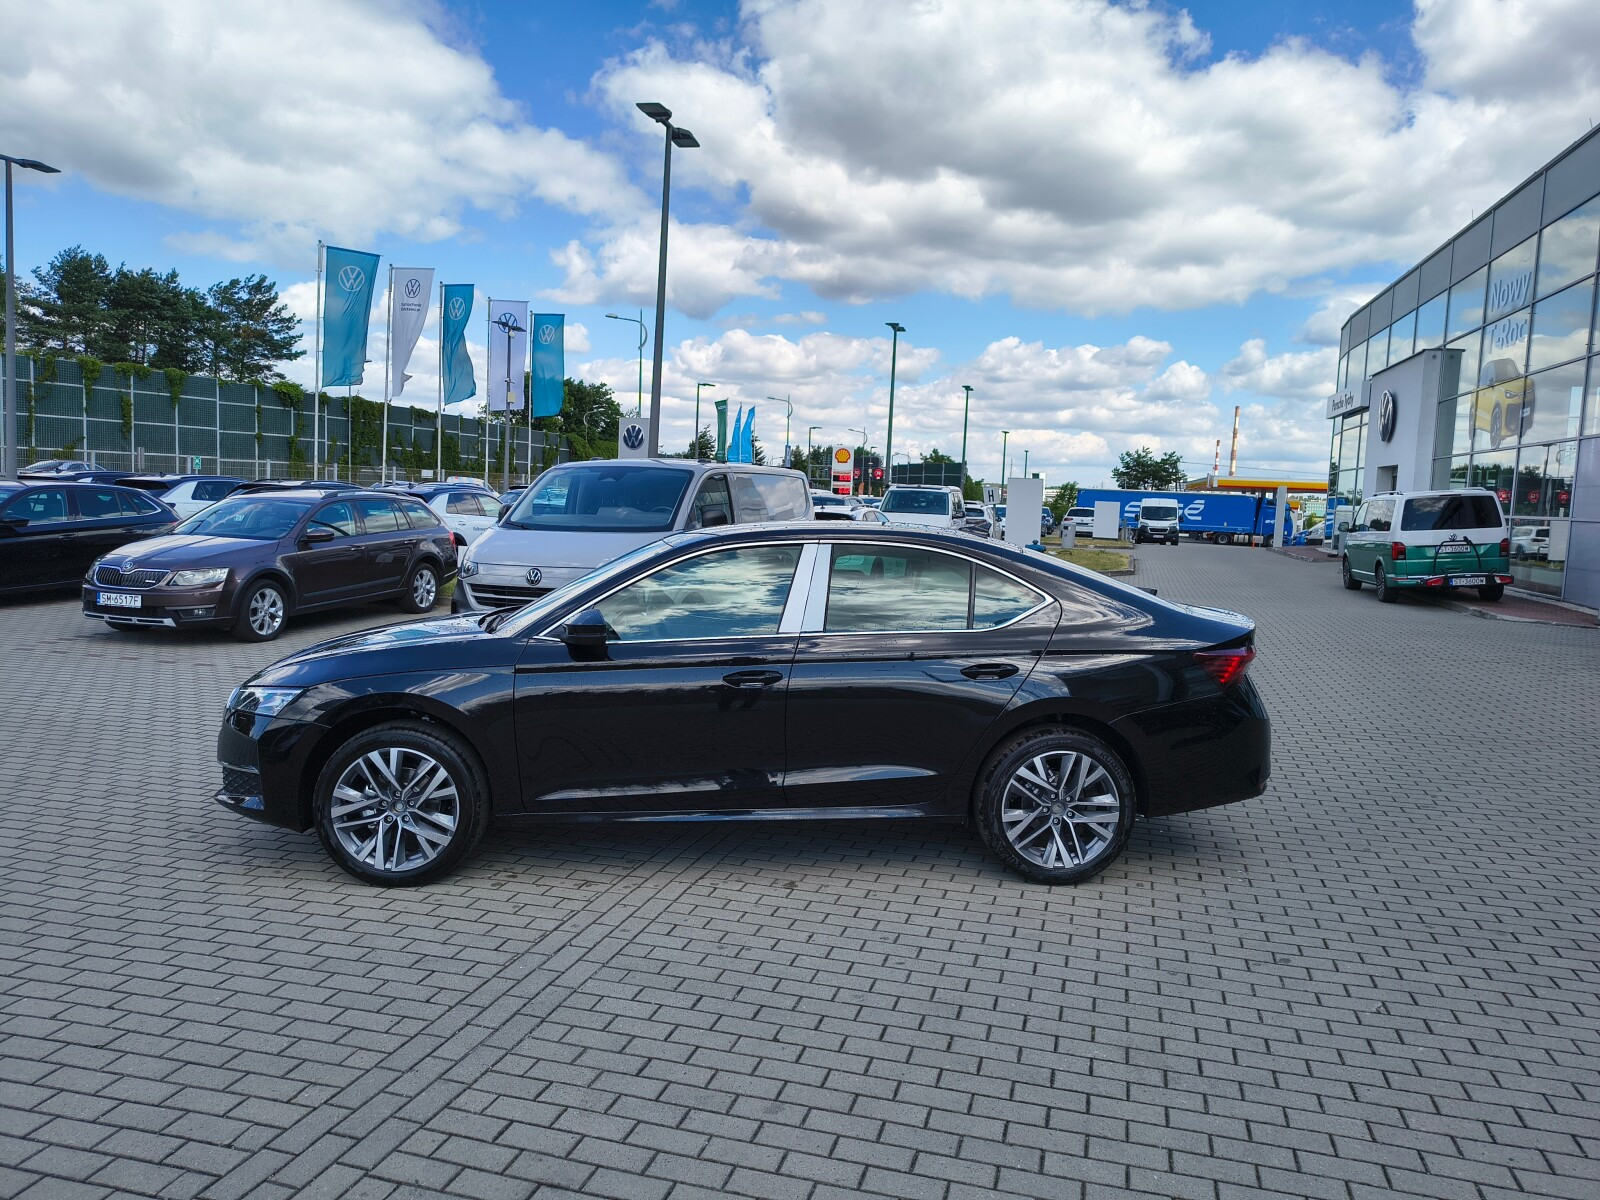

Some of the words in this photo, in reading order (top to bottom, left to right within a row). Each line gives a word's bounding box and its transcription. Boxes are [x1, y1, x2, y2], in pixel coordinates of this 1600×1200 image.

[1491, 271, 1533, 312] Nowy
[1488, 318, 1528, 354] T-Roc
[623, 423, 645, 450] VW
[987, 489, 995, 502] H
[525, 568, 542, 586] VW
[101, 593, 112, 603] SM
[113, 594, 139, 605] 6517F
[1099, 751, 1124, 781] KUMHO
